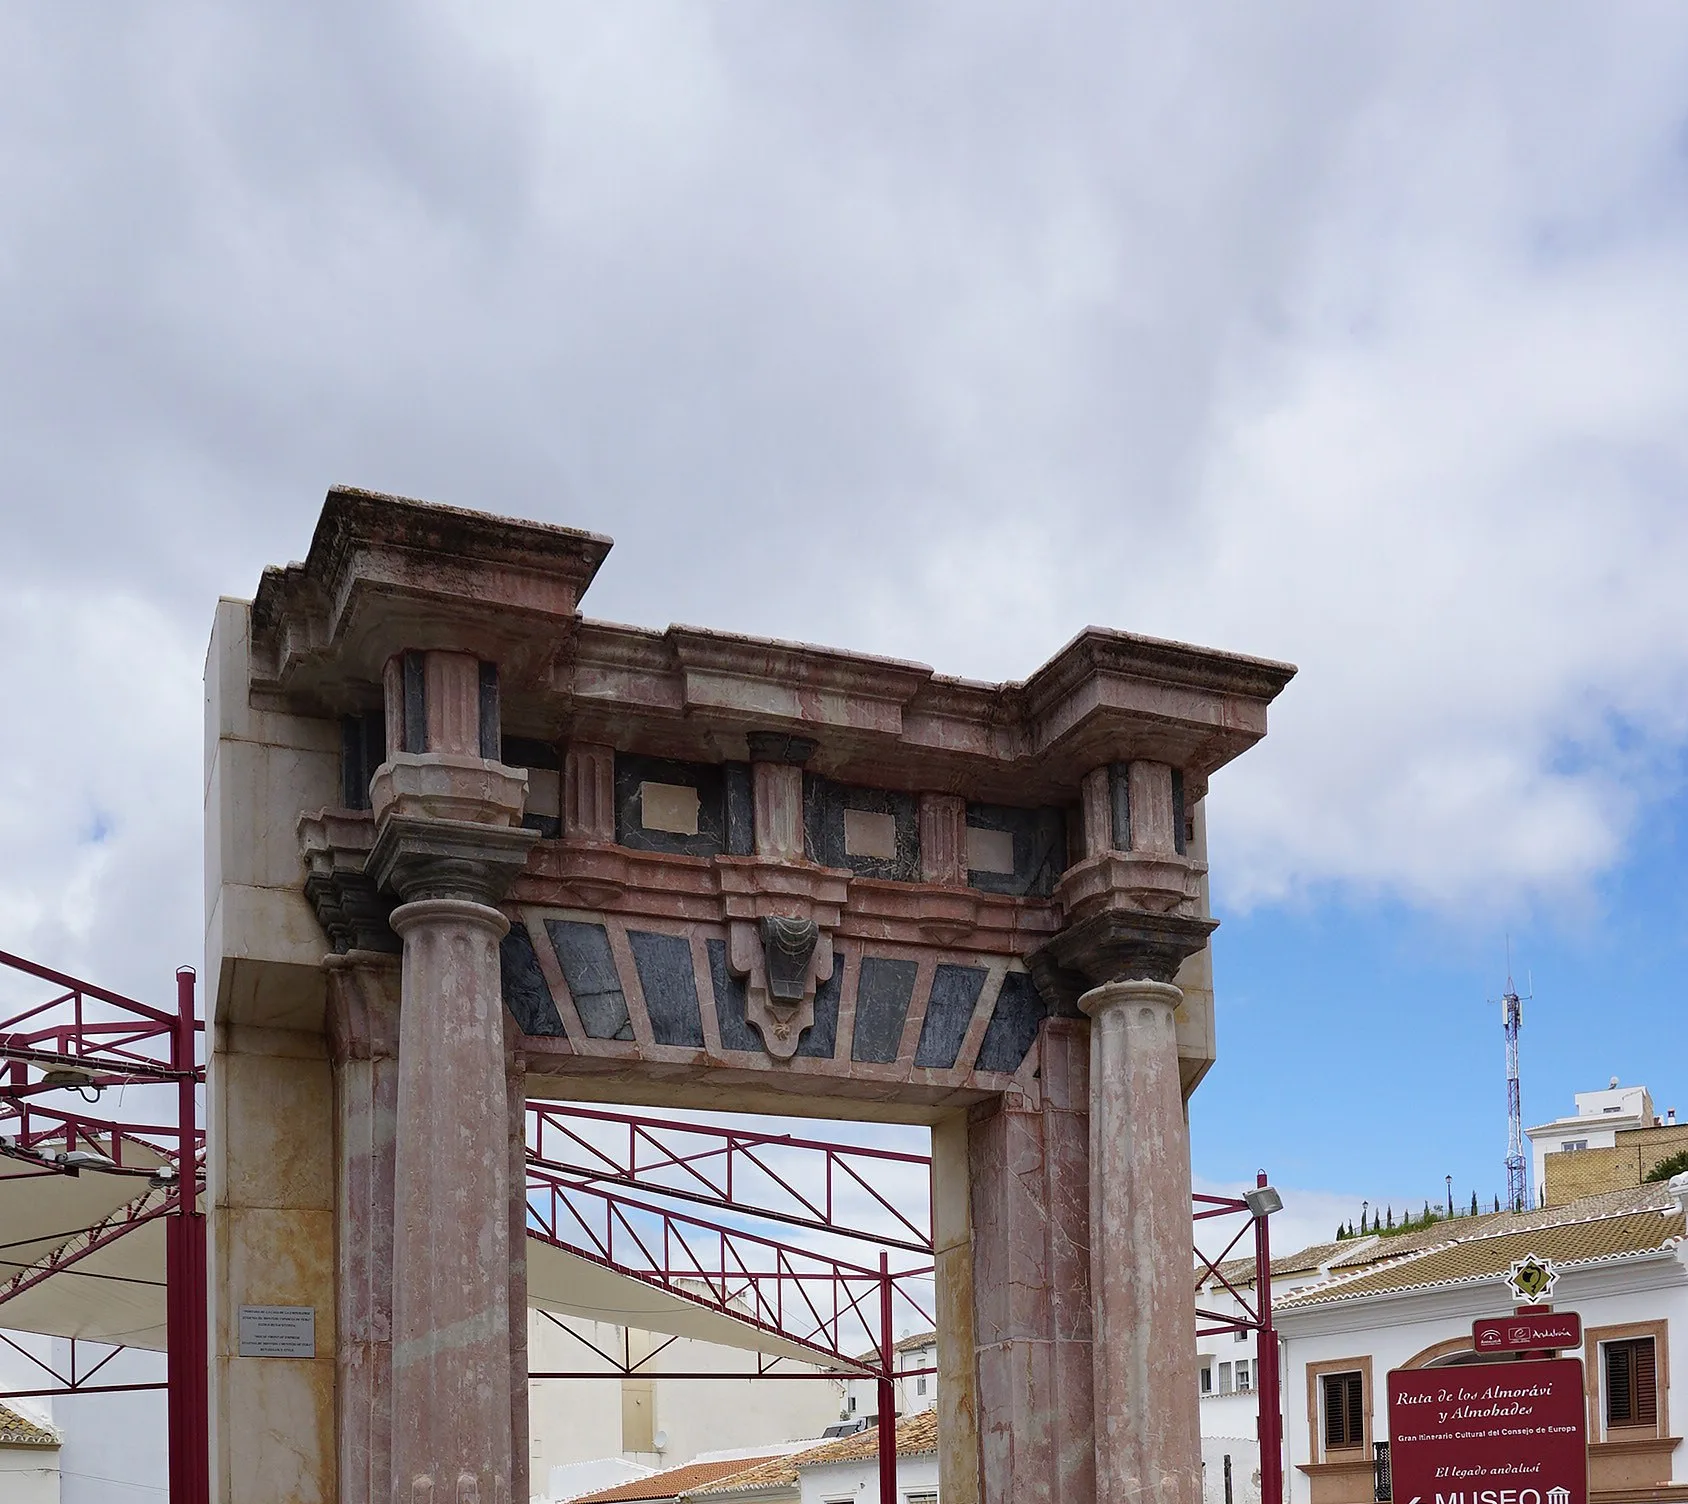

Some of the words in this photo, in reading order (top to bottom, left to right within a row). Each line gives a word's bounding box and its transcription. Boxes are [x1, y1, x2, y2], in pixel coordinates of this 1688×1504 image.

[1396, 1392, 1433, 1405] Ruta
[1438, 1389, 1453, 1402] de
[1458, 1388, 1478, 1401] los
[1480, 1382, 1553, 1400] Almorávi
[1438, 1412, 1448, 1424] y
[1450, 1401, 1533, 1419] Almohades
[1419, 1432, 1453, 1441] Itinerario
[1455, 1430, 1486, 1439] Cultural
[1487, 1429, 1500, 1437] del
[1501, 1427, 1534, 1436] Consejo
[1548, 1425, 1577, 1433] Europa
[1435, 1466, 1449, 1478] El
[1451, 1464, 1487, 1480] legado
[1490, 1462, 1541, 1475] andalusí
